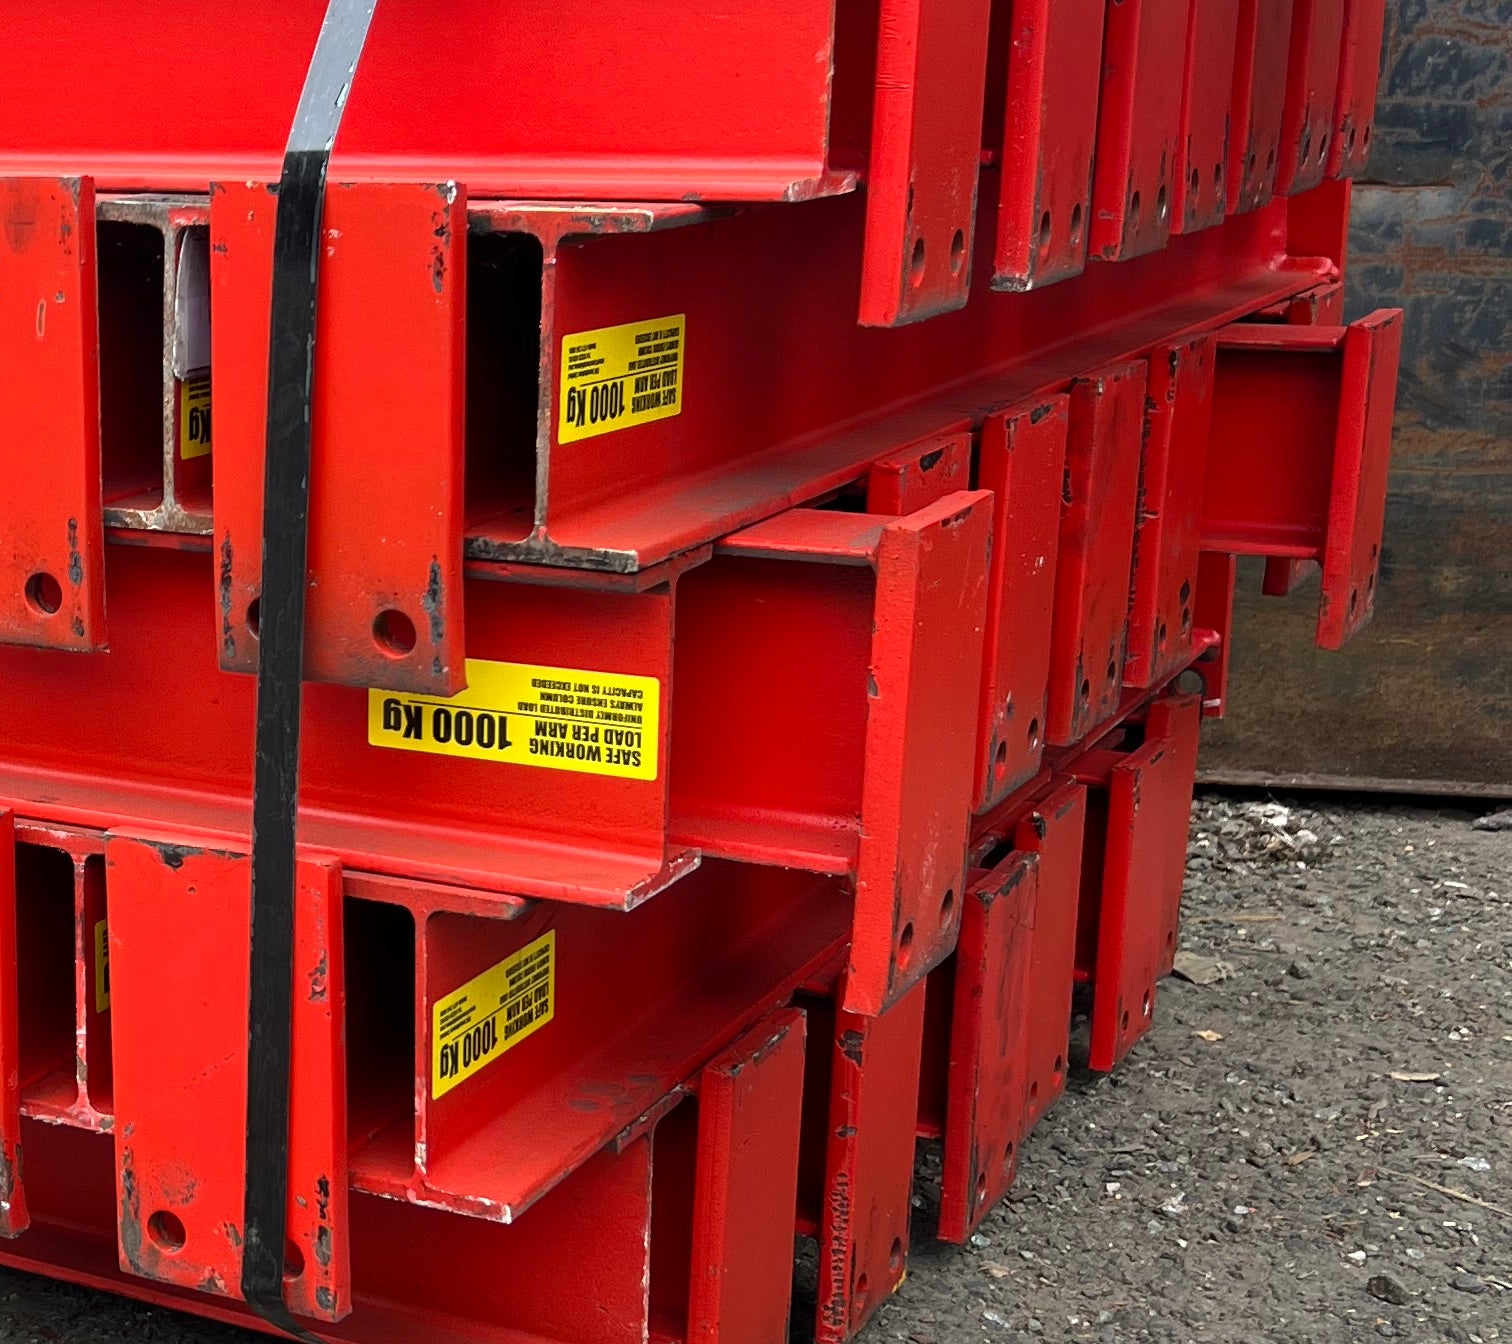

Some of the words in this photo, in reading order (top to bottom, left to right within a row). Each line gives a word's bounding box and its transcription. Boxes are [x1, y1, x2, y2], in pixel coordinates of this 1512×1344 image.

[567, 386, 586, 428] Kg
[590, 380, 625, 424] 1000
[573, 682, 589, 692] NOT
[591, 684, 599, 693] IS
[602, 686, 643, 698] CAPACITY
[517, 701, 537, 711] LOAD
[539, 691, 573, 703] COLUMN
[575, 695, 607, 707] ENSURE
[609, 699, 643, 711] ALWAYS
[383, 698, 423, 740] Kg
[596, 710, 642, 723] UNIFORMLY
[433, 707, 512, 751] 1000
[534, 719, 568, 738] ARM
[571, 724, 599, 742] PER
[604, 727, 641, 747] LOAD
[529, 738, 601, 762] WORKING
[605, 746, 641, 767] SAFE
[463, 1016, 497, 1069] 1000
[440, 1041, 458, 1079] Kg
